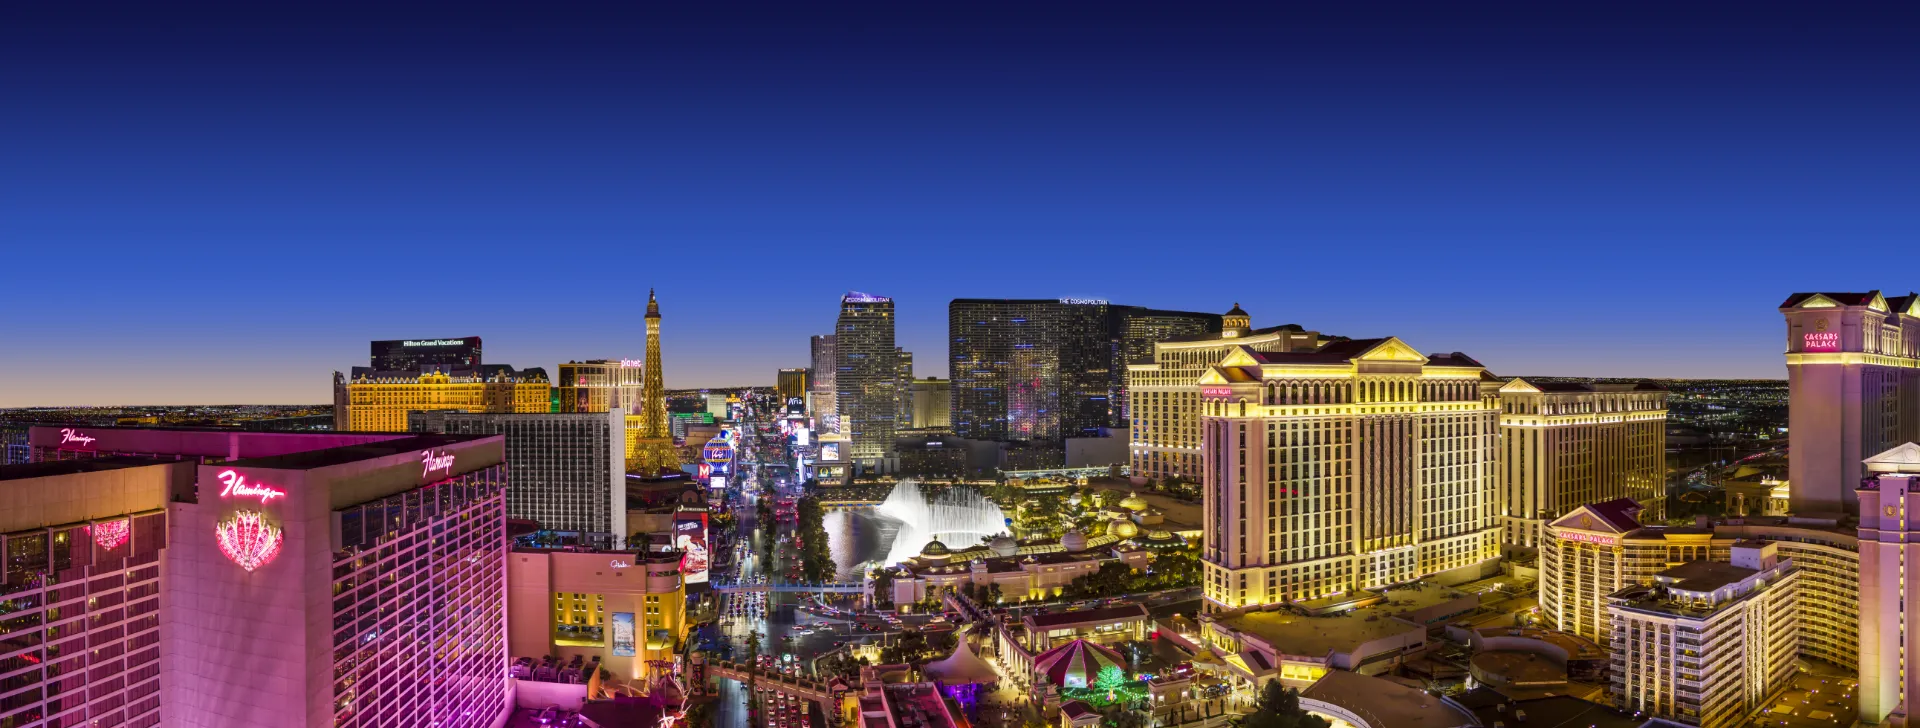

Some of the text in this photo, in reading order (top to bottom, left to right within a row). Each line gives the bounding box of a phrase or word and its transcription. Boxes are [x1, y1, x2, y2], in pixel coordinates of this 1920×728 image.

[1804, 332, 1838, 341] CAESARS
[1806, 340, 1836, 348] PALACE
[621, 357, 641, 368] planet
[61, 428, 95, 446] Flamingo
[421, 450, 455, 478] Flamingo
[217, 469, 285, 503] Flamingo
[1560, 531, 1614, 545] CAESARS PALACE
